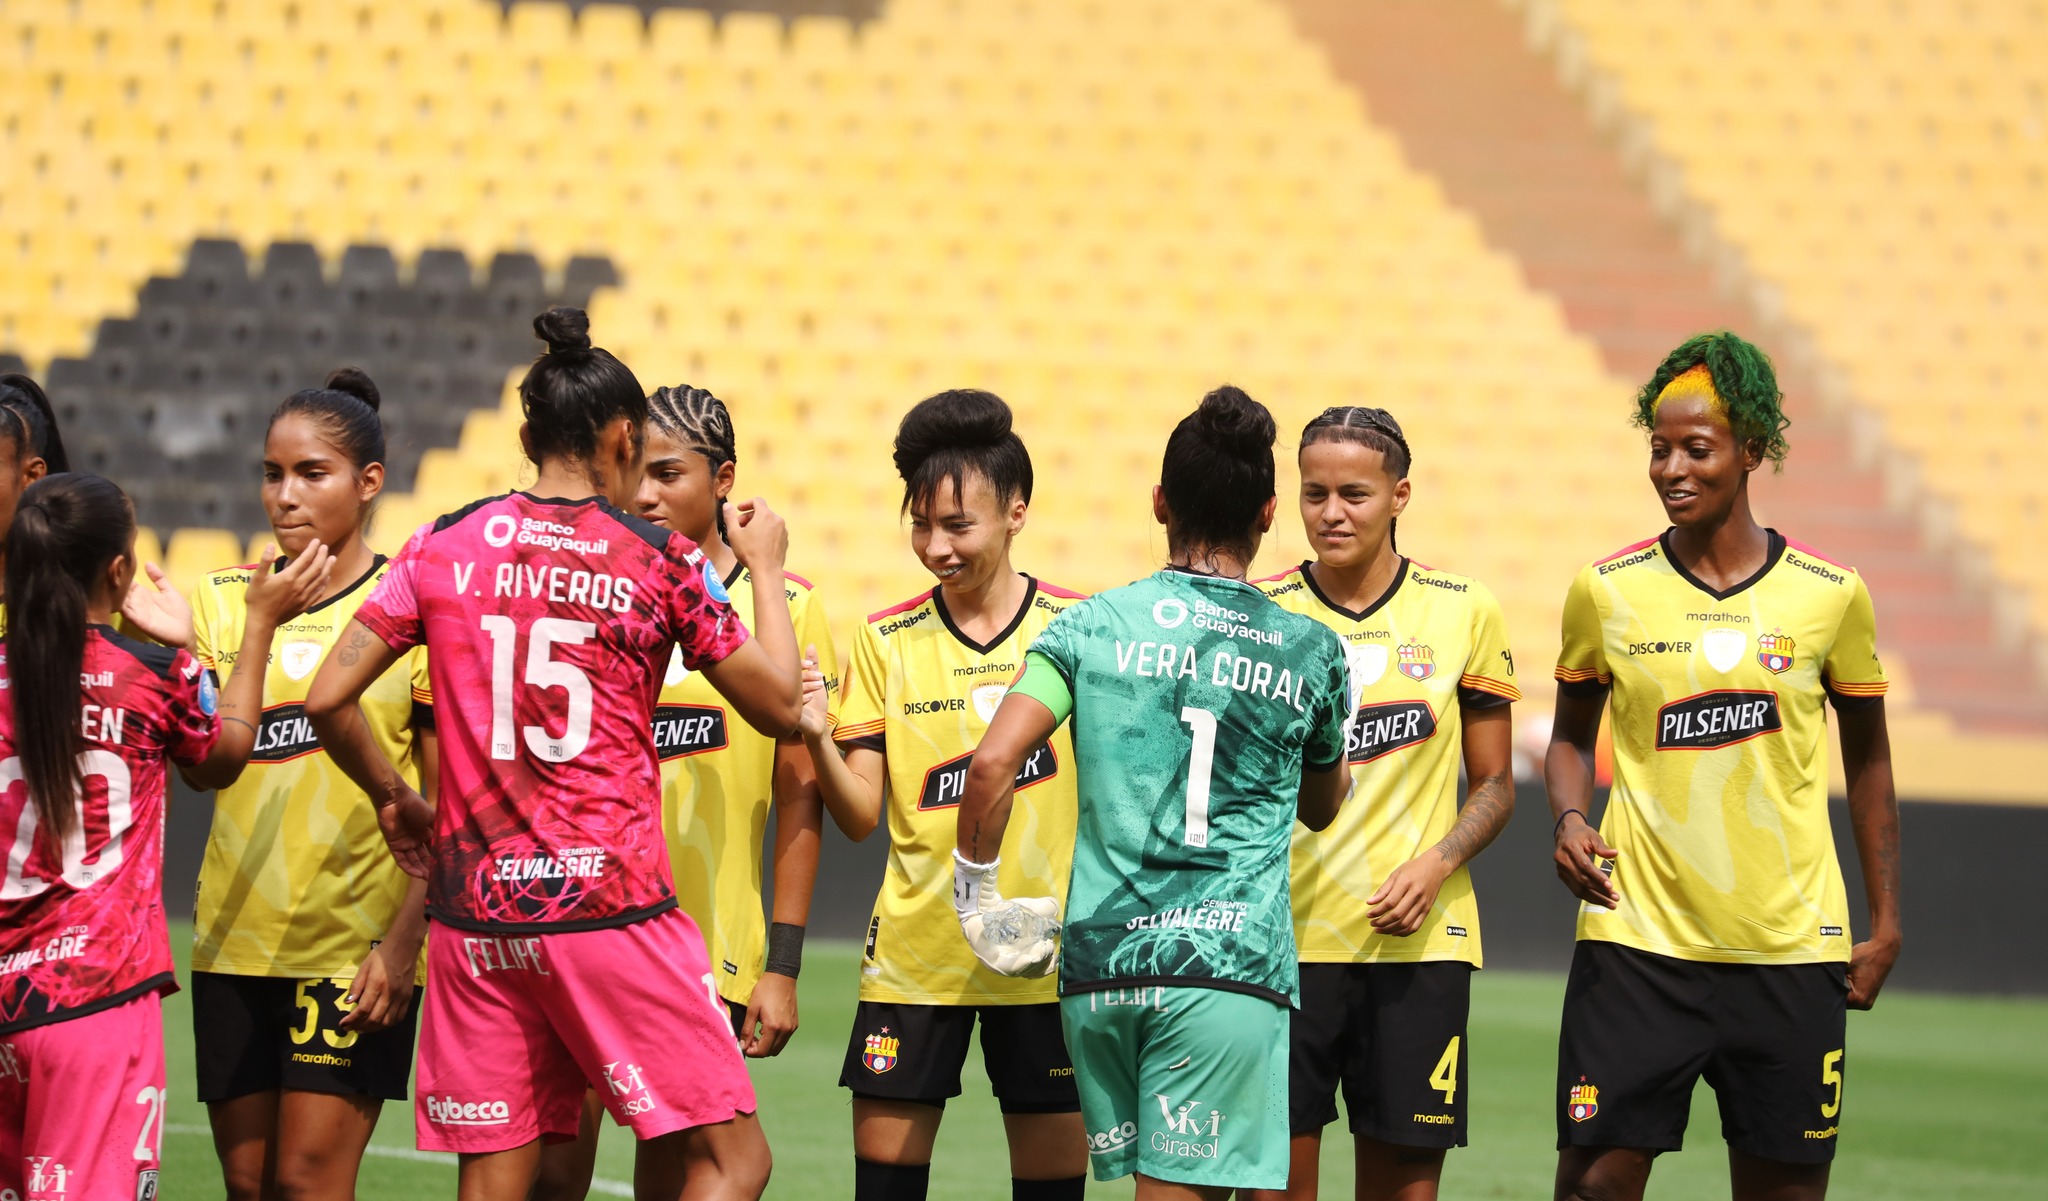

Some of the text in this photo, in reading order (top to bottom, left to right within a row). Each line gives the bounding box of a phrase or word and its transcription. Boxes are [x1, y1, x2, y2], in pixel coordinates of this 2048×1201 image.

[520, 517, 575, 536] Banco
[516, 530, 609, 556] Guayaquil
[1598, 548, 1658, 576] Ecuabet
[1785, 553, 1846, 586] Ecuabet
[453, 561, 634, 614] V. RIVEROS
[1411, 571, 1469, 593] Ecuabet
[1194, 599, 1250, 623] Banco
[1686, 611, 1751, 624] marathon
[1192, 613, 1283, 647] Guayaquil
[1629, 641, 1693, 656] DISCOVER
[953, 662, 1015, 677] marathon
[1115, 638, 1305, 713] VERA CORAL
[480, 614, 597, 764] 15
[904, 698, 966, 716] DISCOVER
[1662, 700, 1769, 743] PILSENER
[1180, 706, 1218, 849] 1
[558, 846, 605, 857] CEMENTO
[492, 855, 606, 881] SELVALEGRE
[1126, 905, 1248, 933] SELVALEGRE
[1202, 899, 1248, 911] CEMENTO
[463, 937, 550, 978] FELIPE
[292, 1052, 351, 1068] marathon
[1428, 1035, 1461, 1105] 4
[1821, 1048, 1843, 1119] 5
[1151, 1130, 1218, 1159] Girasol
